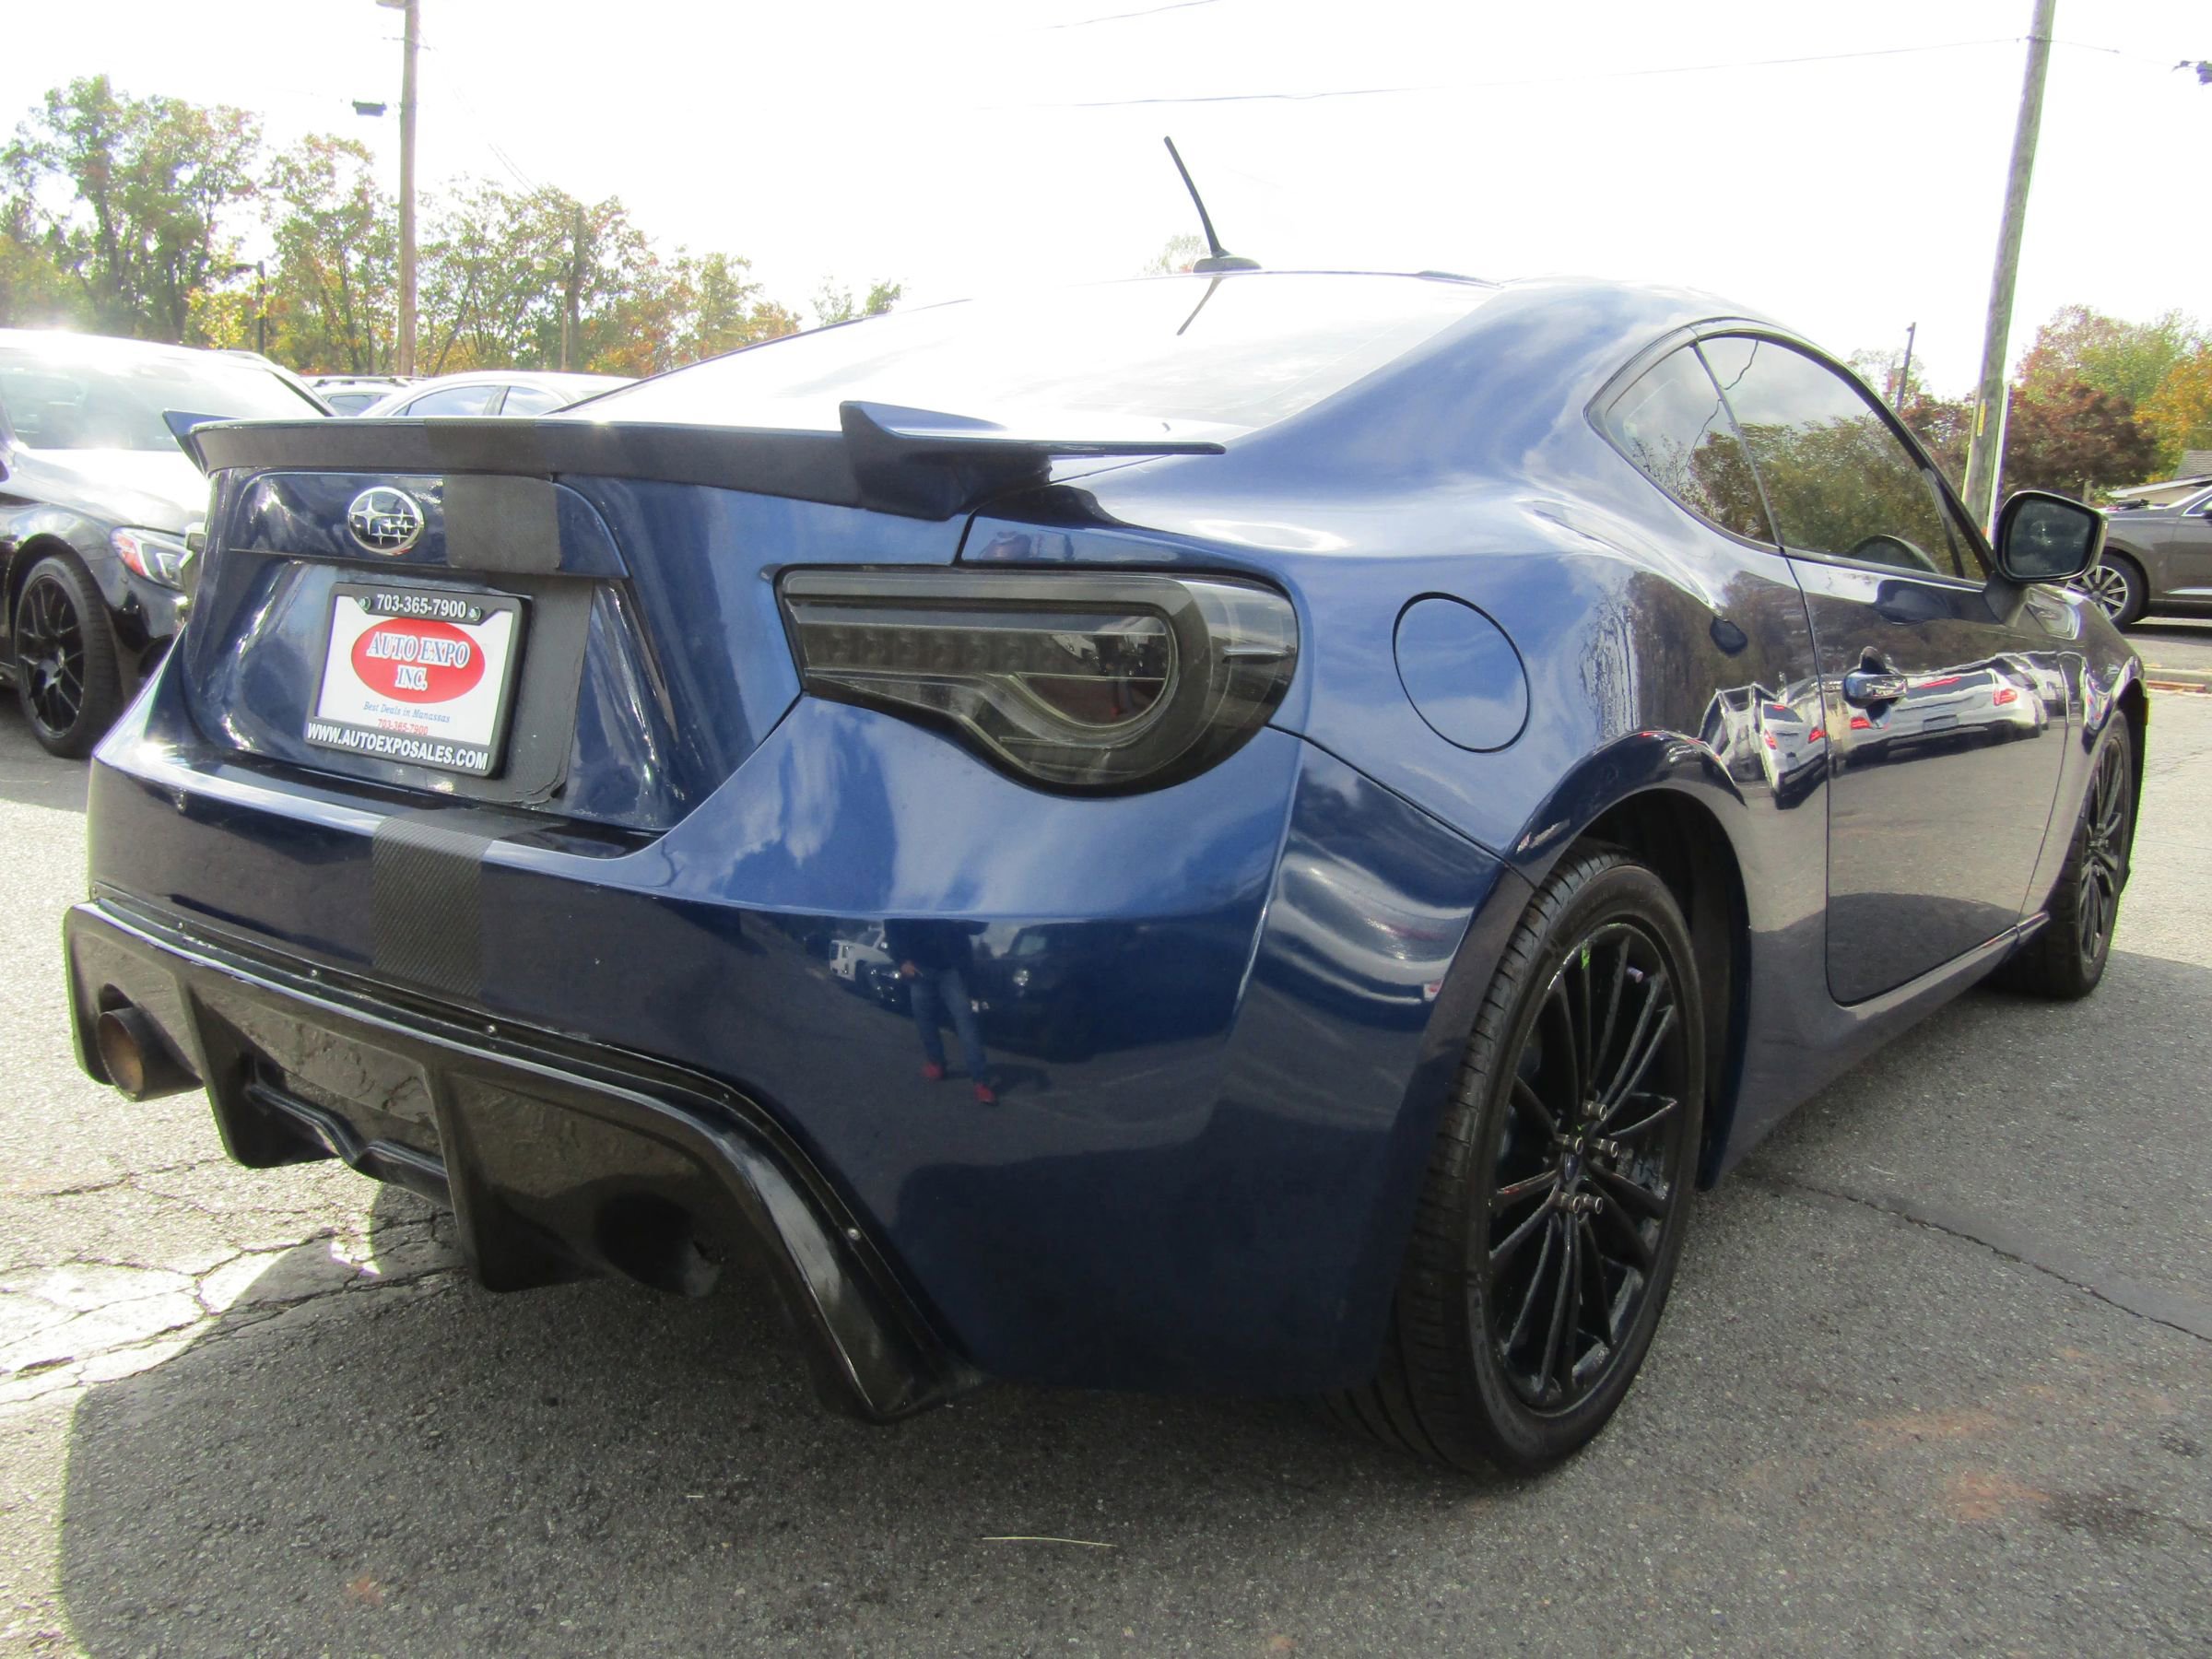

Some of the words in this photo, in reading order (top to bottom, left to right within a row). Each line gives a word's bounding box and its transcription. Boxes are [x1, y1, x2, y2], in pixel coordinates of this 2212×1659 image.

[376, 594, 466, 618] 703-365-7900
[367, 631, 417, 661] AUTO
[418, 636, 471, 668] EXPO
[395, 665, 429, 690] INC.
[363, 700, 379, 712] Best
[381, 703, 401, 716] Deals
[403, 707, 411, 716] in
[412, 708, 451, 723] Manassas
[378, 719, 429, 735] 703-365-7900
[308, 723, 488, 770] WWW.AUTOEXPOSALES.COM
